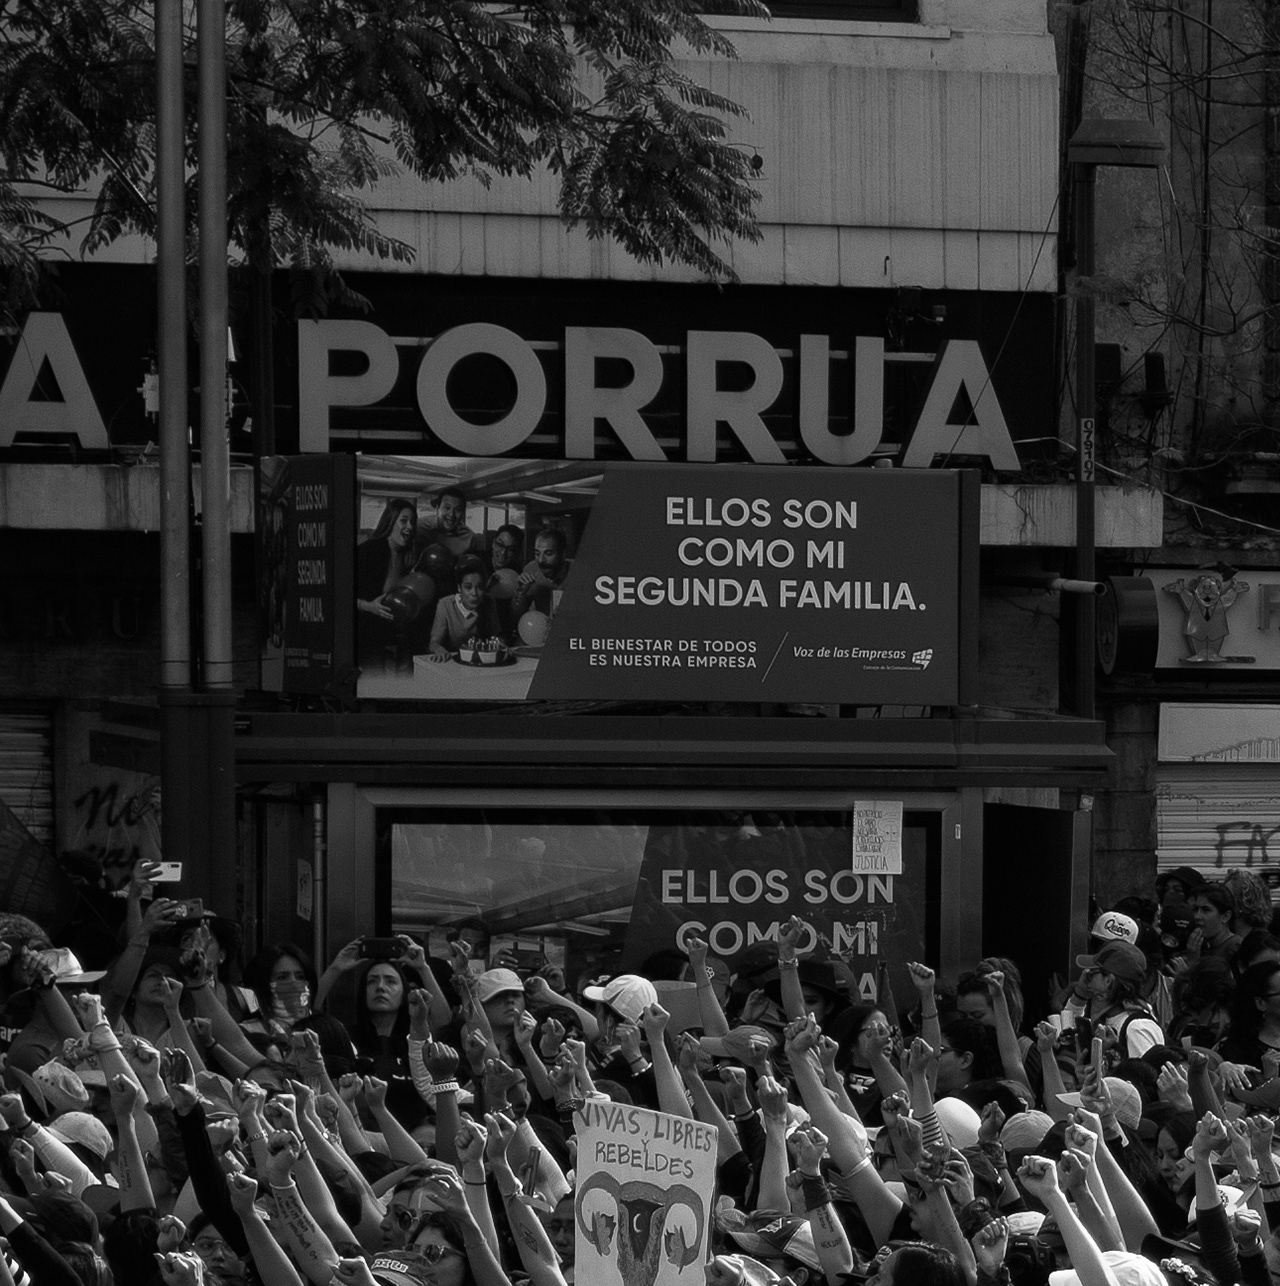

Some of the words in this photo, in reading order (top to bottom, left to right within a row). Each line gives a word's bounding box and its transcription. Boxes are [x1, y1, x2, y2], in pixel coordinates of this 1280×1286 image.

[666, 496, 771, 528] ELLOS
[783, 499, 858, 530] SON
[677, 537, 795, 570] COMO
[806, 539, 845, 570] MI
[594, 576, 768, 607] SEGUNDA
[779, 579, 927, 611] FAMILIA.
[569, 638, 586, 650] EL
[591, 639, 672, 651] BIENESTAR
[678, 640, 698, 652] DE
[703, 640, 757, 653] TODOS
[589, 654, 607, 666] ES
[613, 654, 682, 667] NUESTRA
[687, 655, 757, 668] EMPRESA
[793, 646, 814, 657] Voz
[817, 647, 831, 658] de
[833, 647, 849, 658] las
[851, 647, 905, 660] Empresas
[662, 869, 789, 904] ELLOS
[804, 869, 894, 904] SON
[641, 1140, 649, 1152] Y
[654, 1112, 712, 1151] LIBRES
[596, 1141, 694, 1179] REBELDES
